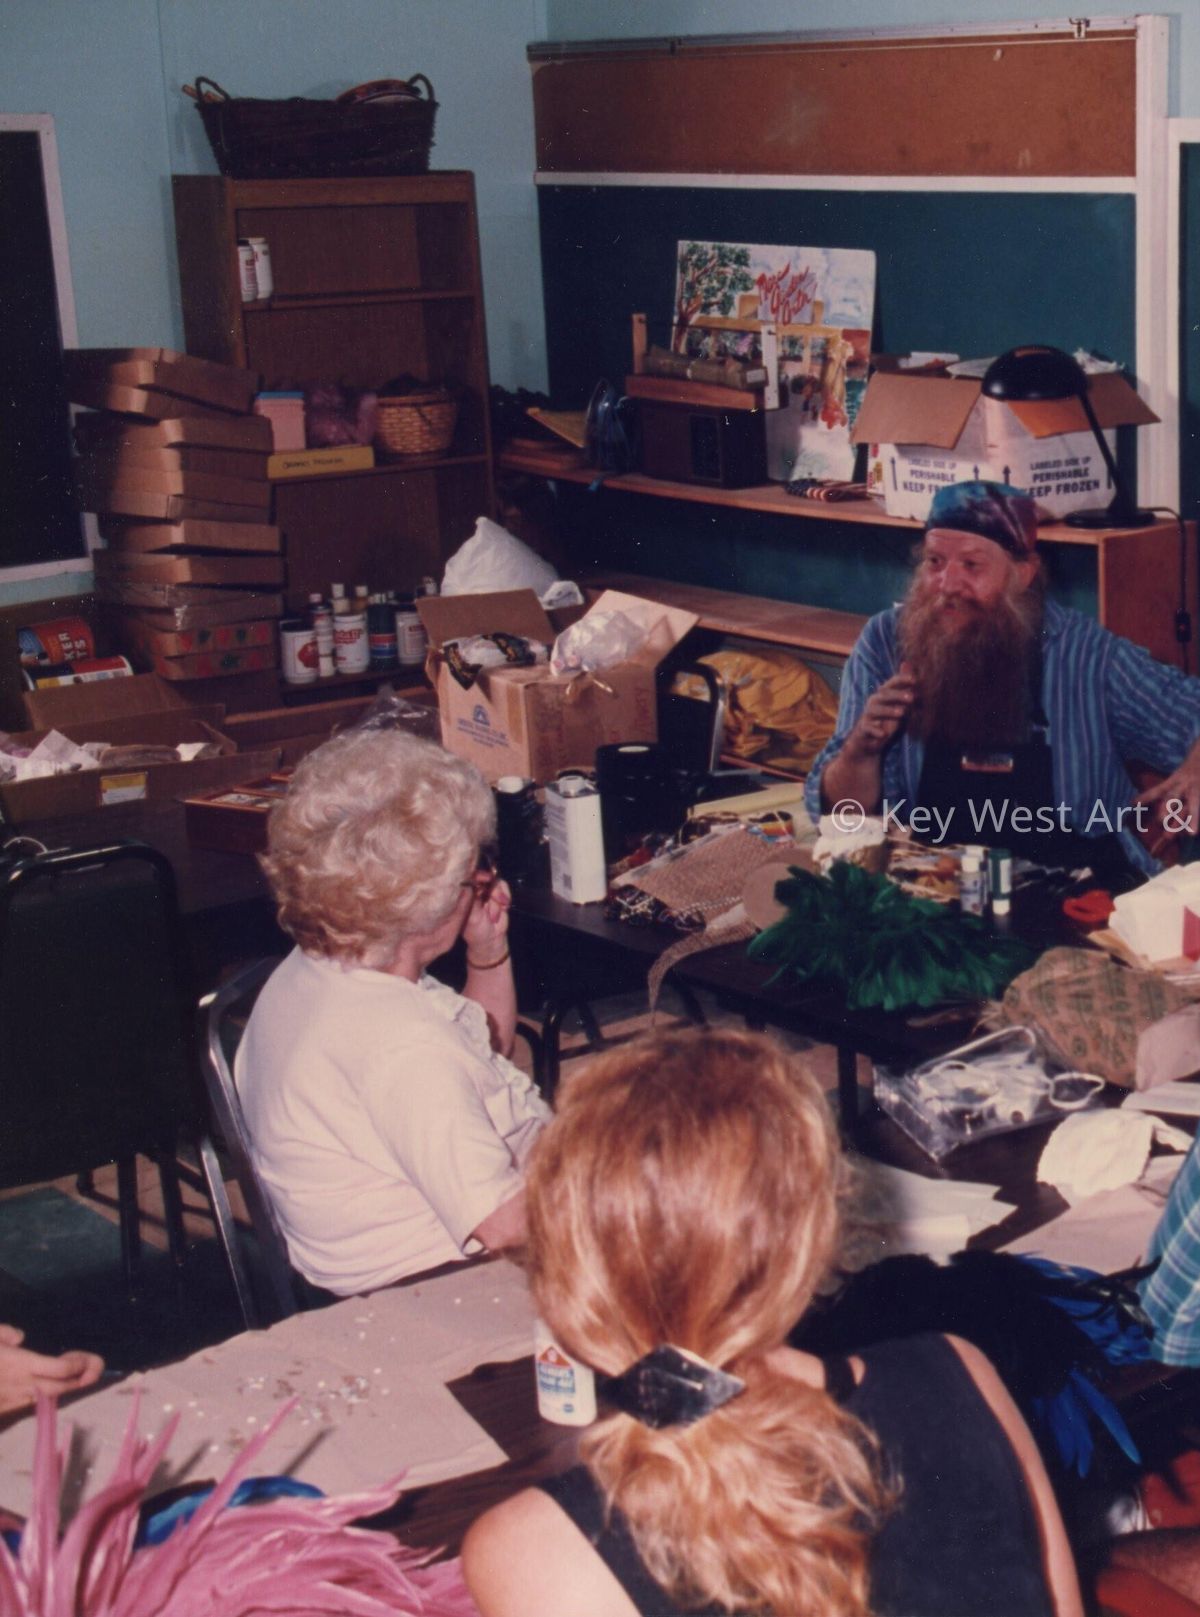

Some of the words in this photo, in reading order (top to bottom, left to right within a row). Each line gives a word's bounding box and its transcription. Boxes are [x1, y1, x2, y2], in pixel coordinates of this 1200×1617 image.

[1030, 460, 1061, 470] LABELED
[1063, 458, 1080, 468] SIDE
[1082, 456, 1092, 464] UP
[910, 469, 955, 482] PERISHABLE
[1032, 467, 1089, 482] PERISHABLE
[903, 481, 925, 493] KEEP
[1056, 480, 1100, 495] FROZEN
